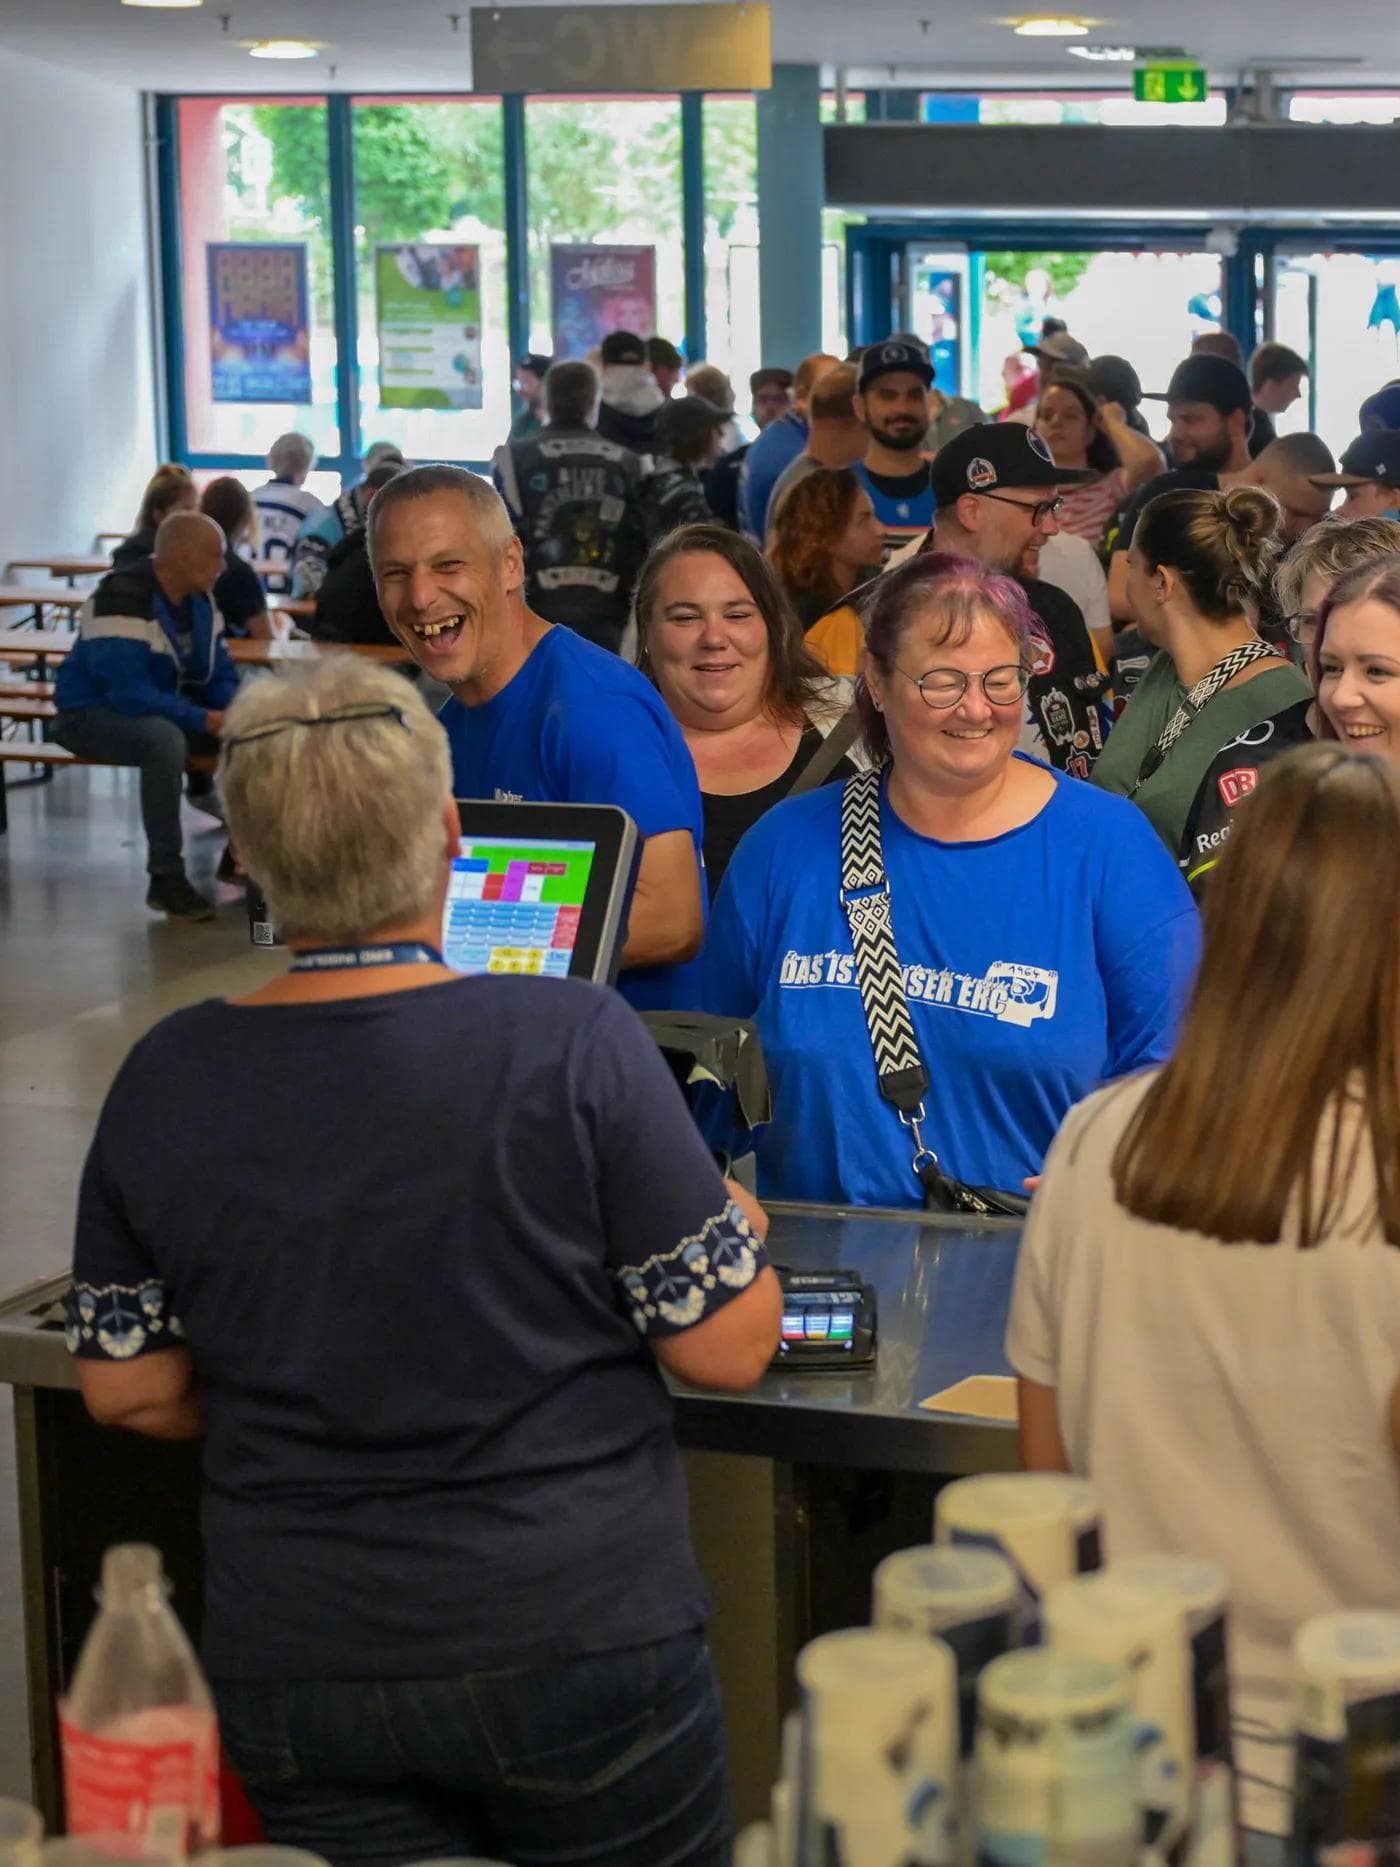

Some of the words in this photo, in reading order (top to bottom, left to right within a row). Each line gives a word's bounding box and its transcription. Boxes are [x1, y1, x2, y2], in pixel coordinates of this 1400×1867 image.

[1224, 772, 1255, 800] DB
[779, 955, 823, 984] DAS
[899, 967, 953, 1002] NSER
[957, 975, 1008, 1015] ERC
[1009, 965, 1040, 978] 1964
